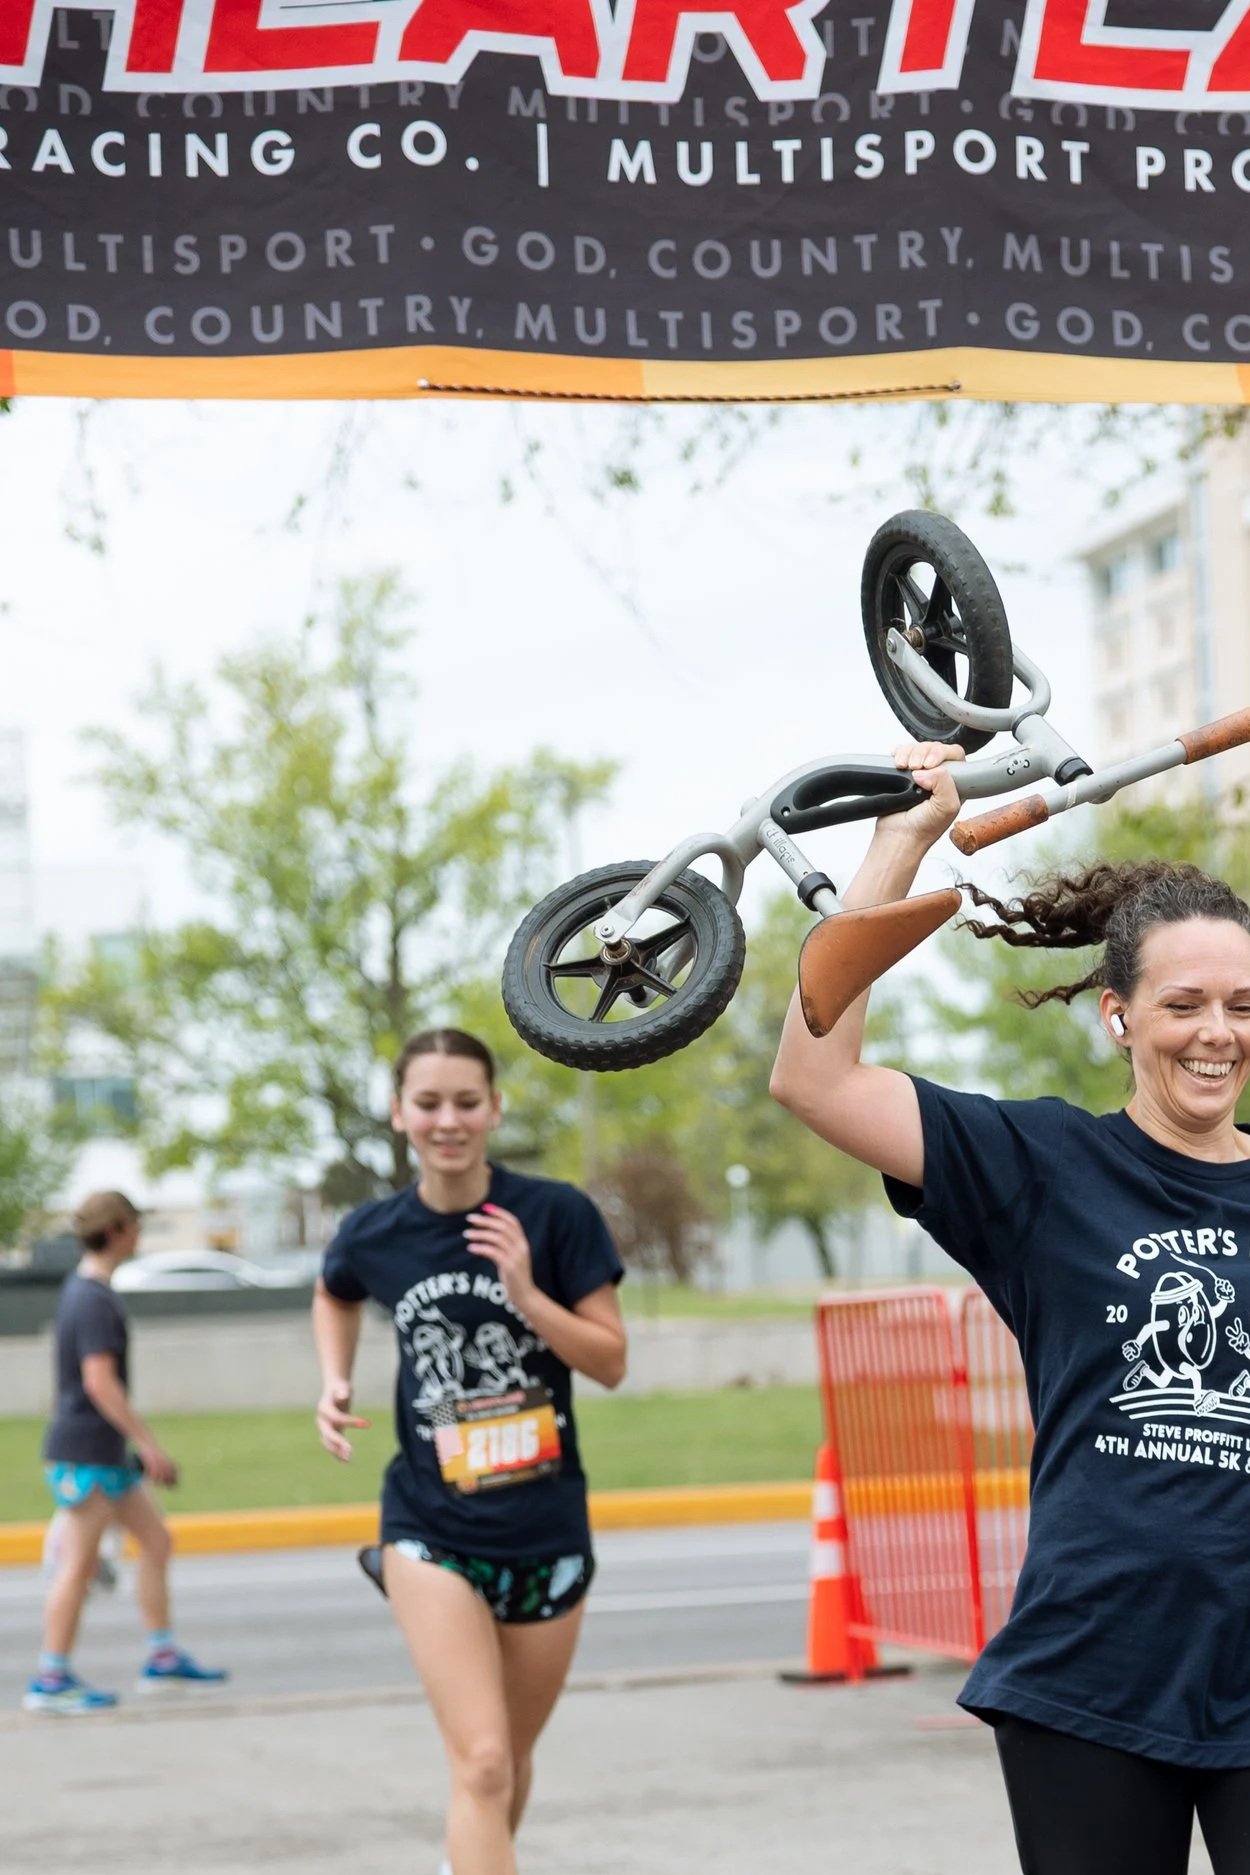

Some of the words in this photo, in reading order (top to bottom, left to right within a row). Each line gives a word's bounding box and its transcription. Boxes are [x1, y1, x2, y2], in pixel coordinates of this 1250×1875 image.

[346, 119, 480, 172] CO.
[606, 129, 1090, 186] MULTISPORT
[462, 226, 617, 279] GOD,
[648, 227, 974, 279] COUNTRY,
[144, 295, 485, 346] COUNTRY,
[514, 298, 944, 350] MULTISPORT
[1005, 302, 1154, 351] GOD,
[1116, 1227, 1238, 1279] POTTER'S
[1106, 1304, 1128, 1323] 20
[1095, 1434, 1129, 1457] 4TH
[1134, 1439, 1214, 1467] ANNUAL
[1218, 1452, 1241, 1472] 5K
[1143, 1423, 1181, 1440] STEVE
[1184, 1426, 1243, 1449] PROFFITT
